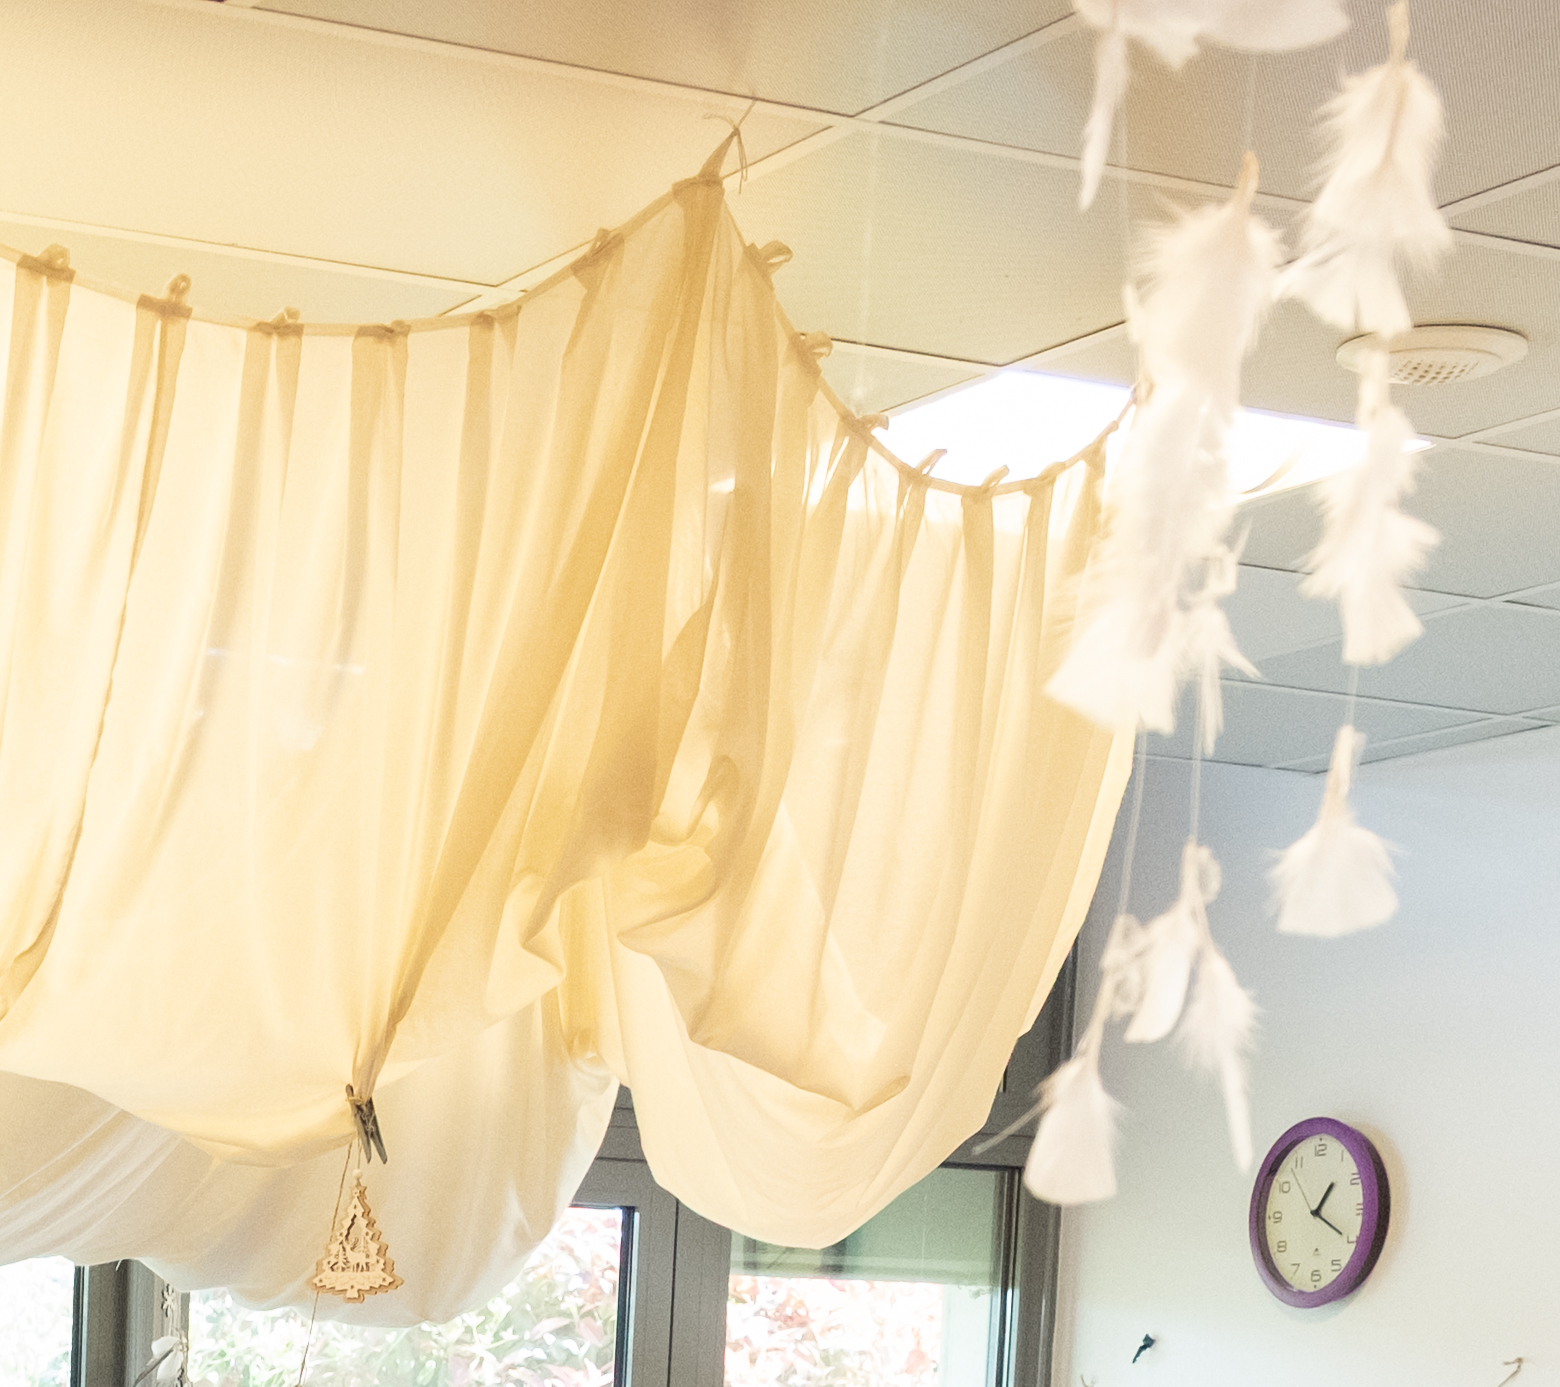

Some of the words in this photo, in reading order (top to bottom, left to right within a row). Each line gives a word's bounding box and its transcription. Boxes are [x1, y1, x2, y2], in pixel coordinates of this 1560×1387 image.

[1314, 1143, 1327, 1157] 12
[1295, 1156, 1304, 1169] 11
[1279, 1181, 1291, 1194] 10
[1272, 1210, 1283, 1224] 9
[1277, 1240, 1287, 1253] 8
[1291, 1263, 1301, 1275] 7
[1331, 1259, 1342, 1272] 5
[1310, 1269, 1321, 1282] 6
